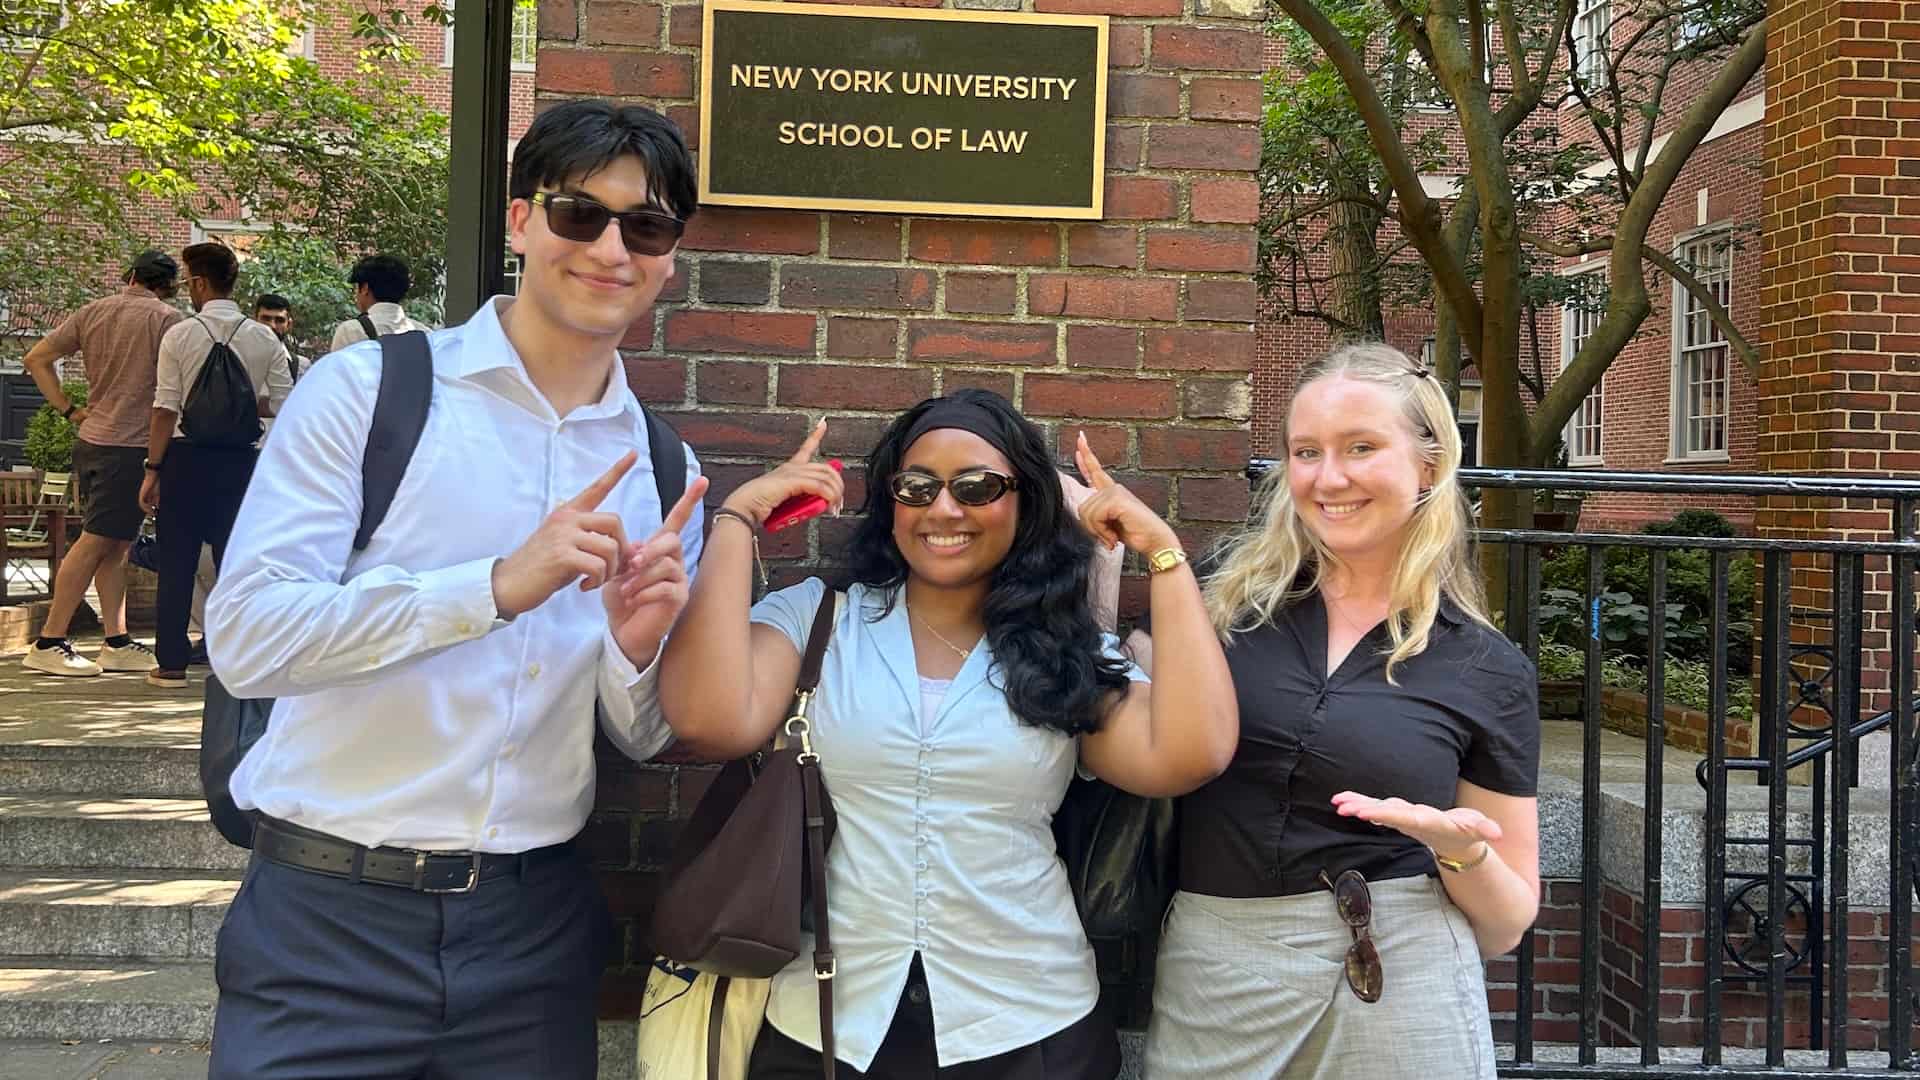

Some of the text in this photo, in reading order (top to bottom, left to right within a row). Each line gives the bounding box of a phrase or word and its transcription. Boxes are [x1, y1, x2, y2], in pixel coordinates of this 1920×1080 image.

[731, 64, 1077, 101] NEW YORK UNIVERSITY
[778, 122, 1029, 154] SCHOOL OF LAW
